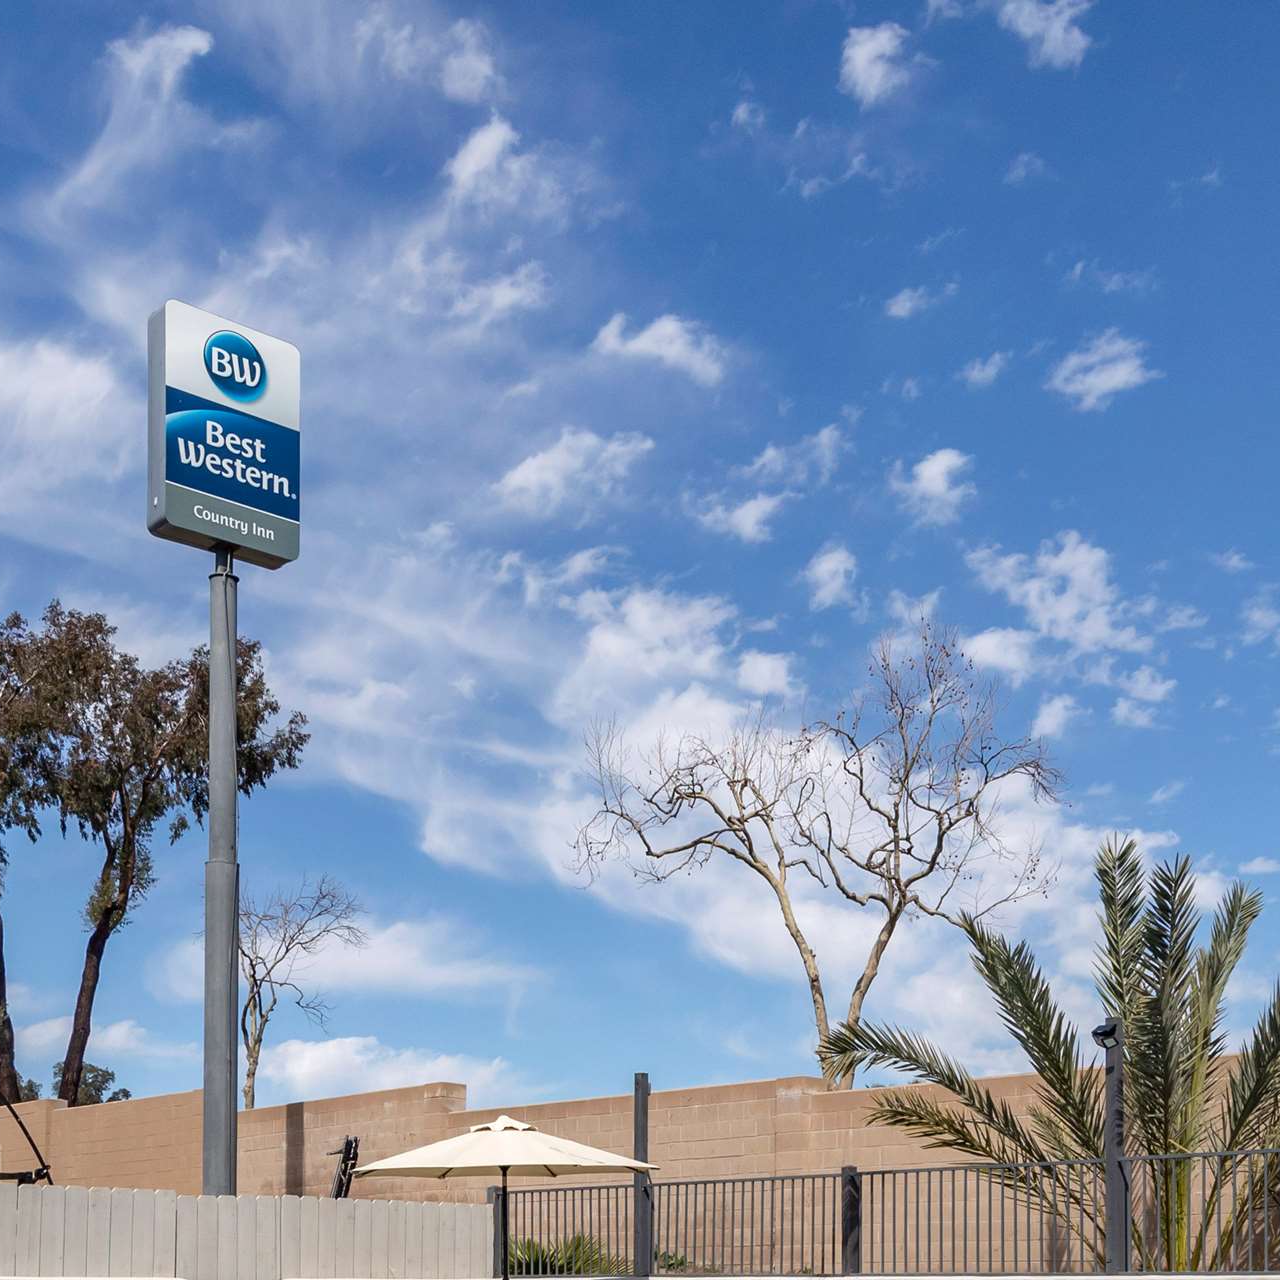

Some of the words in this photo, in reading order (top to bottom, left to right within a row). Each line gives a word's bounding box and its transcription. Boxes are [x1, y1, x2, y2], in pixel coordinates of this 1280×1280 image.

[211, 346, 261, 388] BW
[206, 420, 266, 464] Best
[193, 505, 248, 535] Country
[252, 522, 275, 541] Inn
